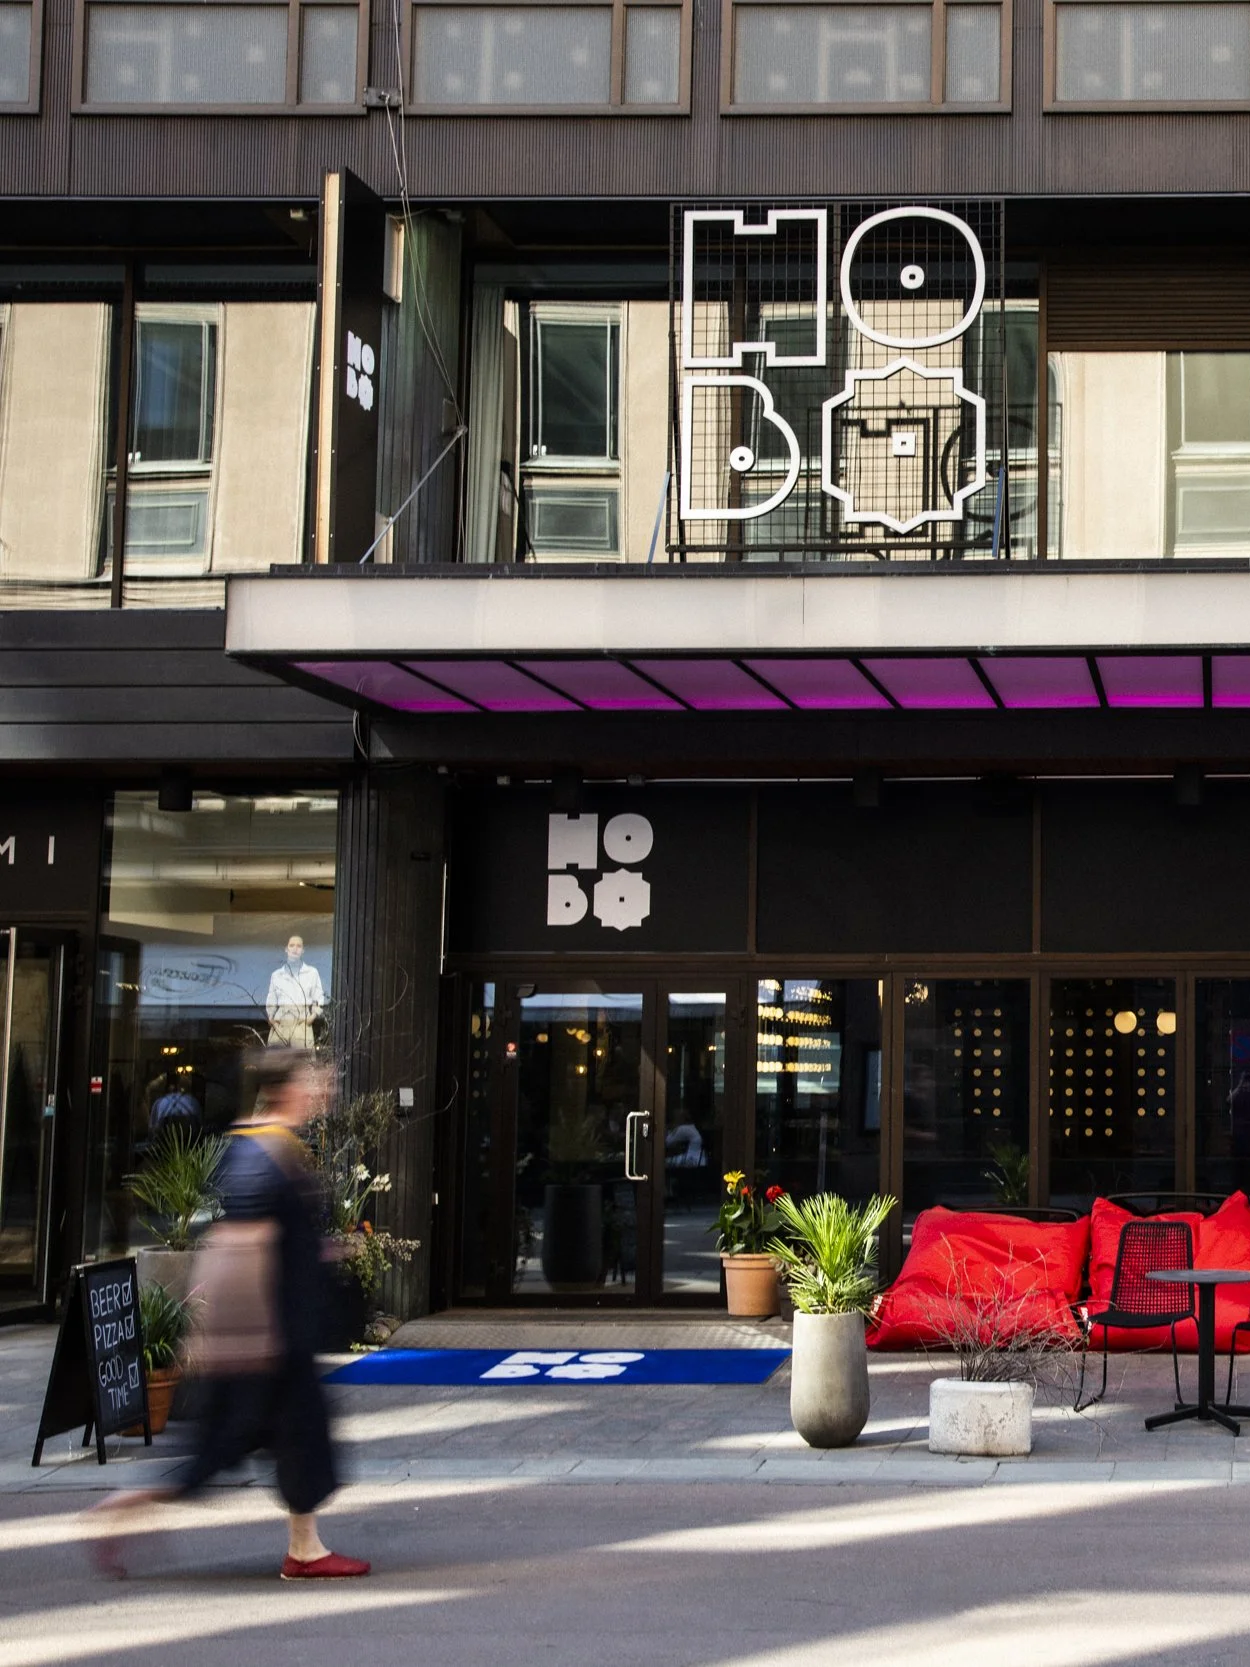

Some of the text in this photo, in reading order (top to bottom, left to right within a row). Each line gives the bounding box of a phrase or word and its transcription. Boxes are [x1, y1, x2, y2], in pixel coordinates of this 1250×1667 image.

[90, 1283, 121, 1318] BEER
[94, 1320, 125, 1350] PIZZA
[98, 1355, 124, 1387] GOOD
[107, 1382, 130, 1411] TIME
